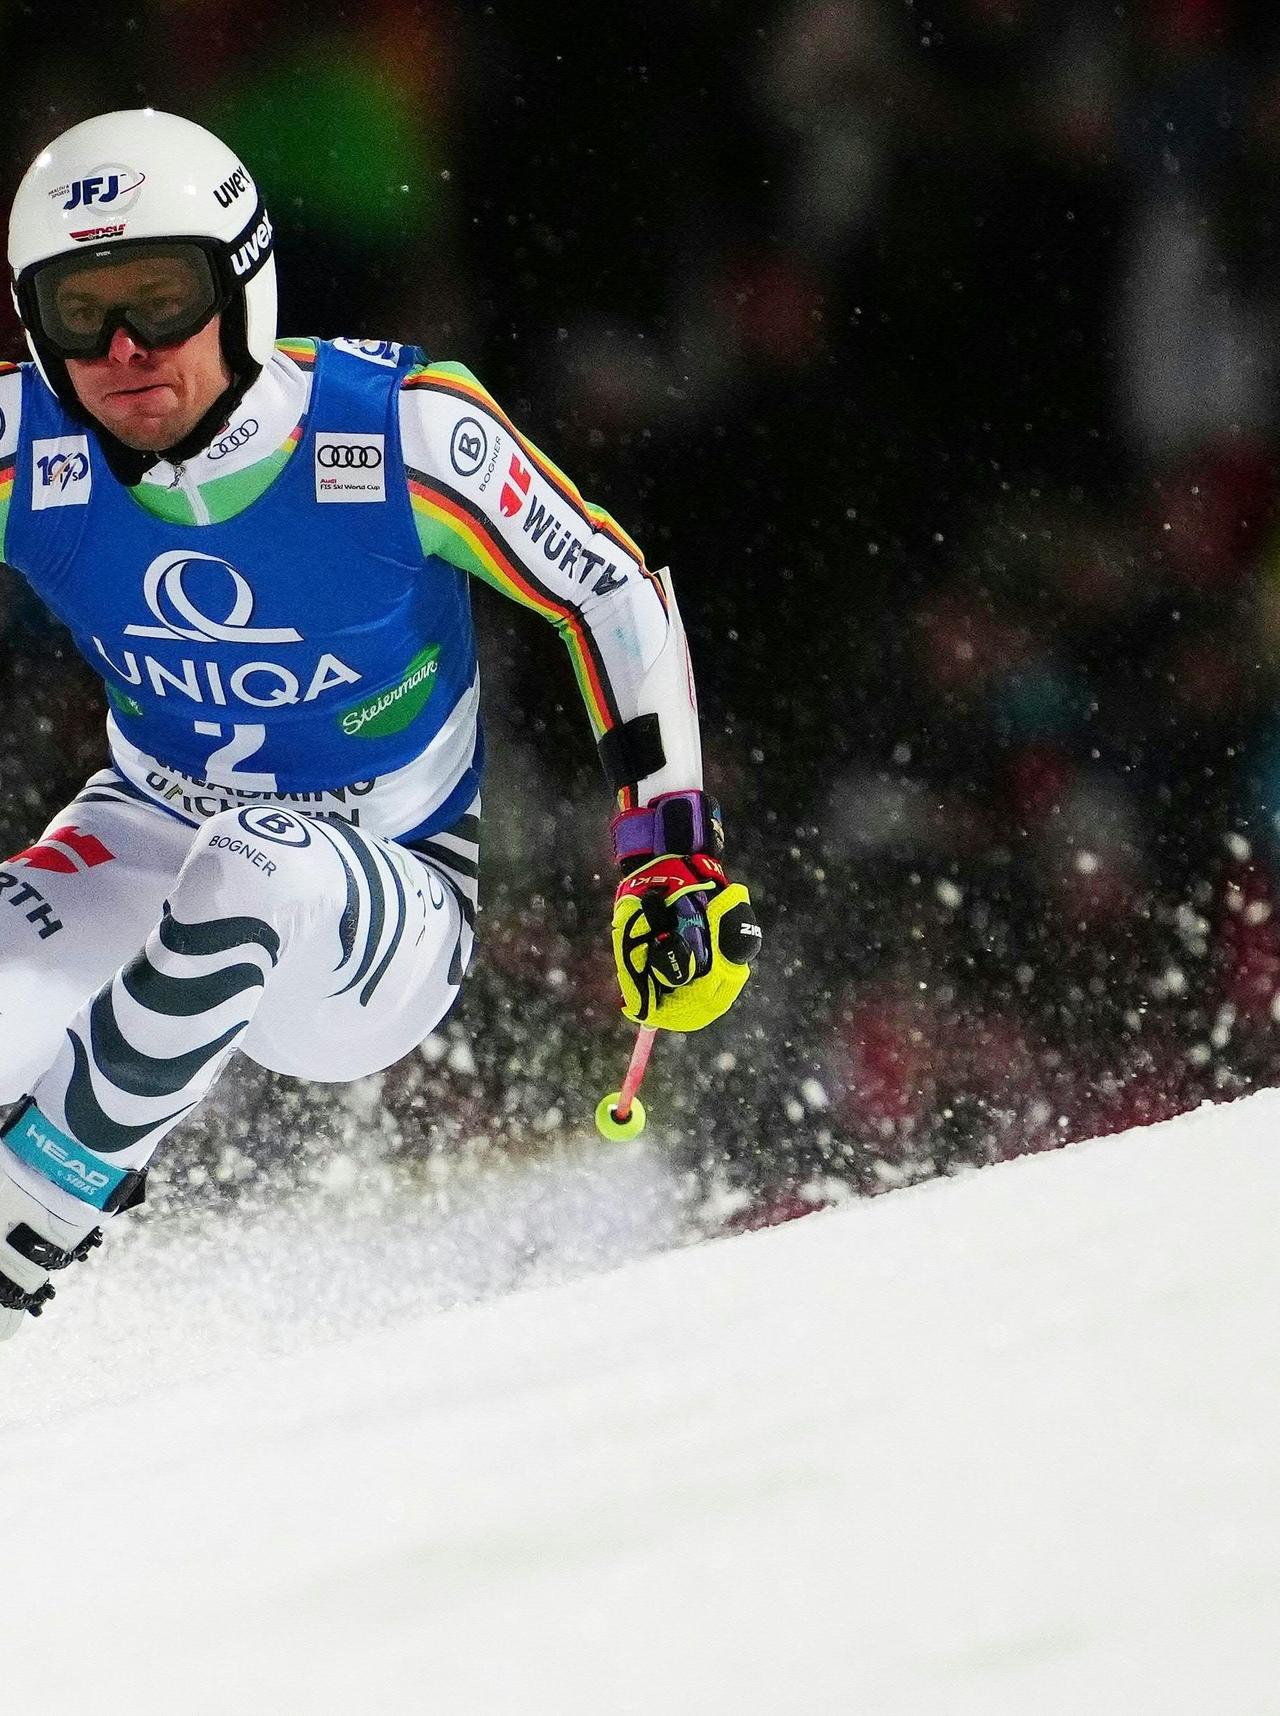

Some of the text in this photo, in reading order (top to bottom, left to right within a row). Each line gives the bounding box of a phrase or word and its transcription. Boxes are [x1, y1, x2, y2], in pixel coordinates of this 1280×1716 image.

[63, 175, 119, 210] JFJ
[213, 166, 250, 208] uvex
[230, 208, 273, 275] uvex
[479, 436, 502, 492] BOGNER
[92, 636, 362, 708] UNIQA
[342, 660, 438, 735] Steiermark
[194, 721, 278, 793] 2
[208, 835, 277, 877] BOGNER
[630, 876, 685, 888] LEKI
[667, 950, 683, 980] LEKI
[26, 1124, 109, 1188] HEAD
